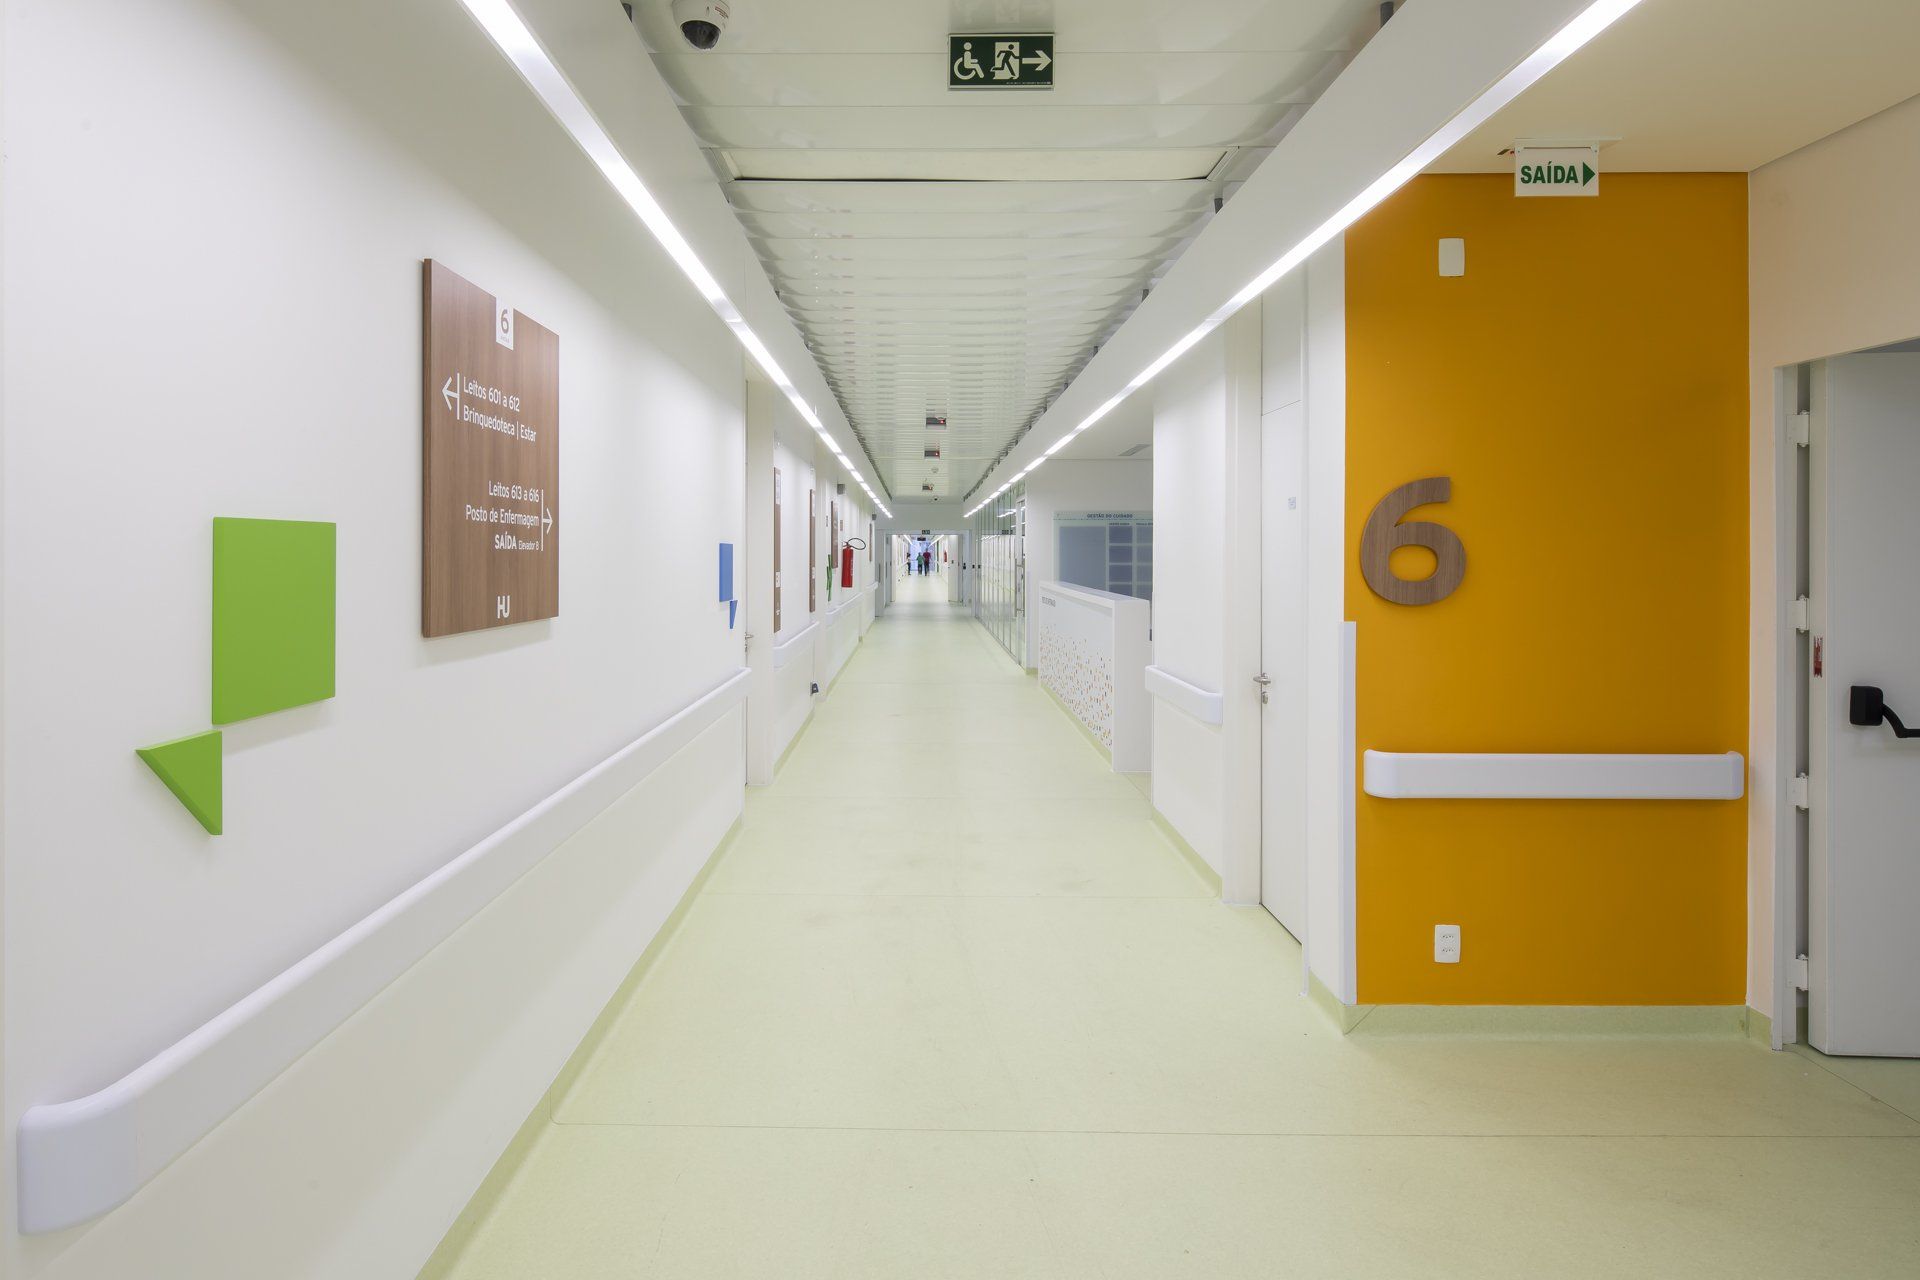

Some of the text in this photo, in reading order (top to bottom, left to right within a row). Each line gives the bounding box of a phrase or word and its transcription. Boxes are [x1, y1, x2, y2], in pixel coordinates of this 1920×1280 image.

[1520, 161, 1579, 184] SAÍDA
[500, 309, 510, 334] 6
[464, 376, 519, 412] Leitos 601 a 612
[464, 405, 536, 442] Brinquedoteca Estar
[488, 480, 510, 498] Leitos
[511, 485, 522, 500] 613
[523, 489, 528, 501] a
[465, 505, 539, 529] Posto de Enfermagem
[494, 531, 517, 550] SAÍDA
[518, 540, 535, 550] Elevador
[1360, 476, 1467, 605] 6
